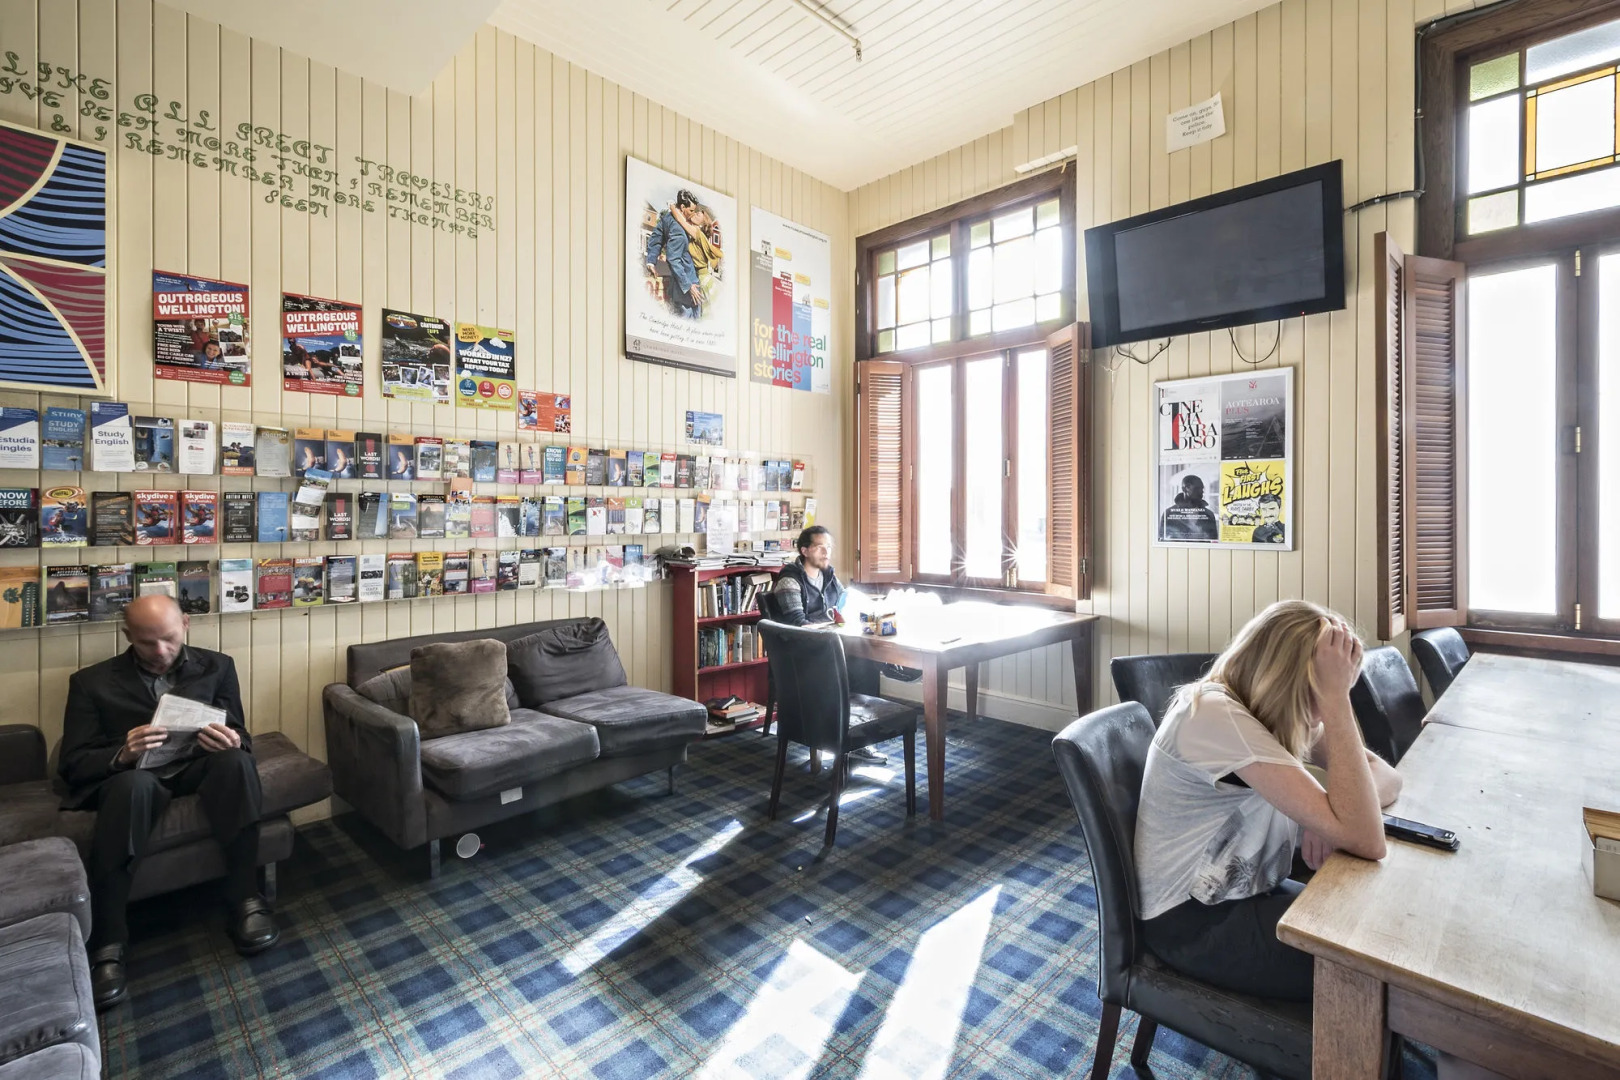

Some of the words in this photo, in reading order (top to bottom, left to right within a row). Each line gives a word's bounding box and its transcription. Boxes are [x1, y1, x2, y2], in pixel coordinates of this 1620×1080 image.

[2, 51, 112, 101] LIKE
[134, 94, 216, 131] ALL
[236, 123, 334, 164] GREAT
[355, 156, 494, 211] TRAVELERS
[1182, 129, 1197, 137] Keep
[1202, 123, 1213, 131] tidy
[51, 114, 71, 133] &
[125, 132, 294, 192] REMEMBER
[309, 183, 375, 212] MORE
[388, 205, 446, 231] THAN
[80, 100, 160, 136] SEEN
[176, 128, 257, 162] MORE
[271, 154, 339, 186] THAN
[367, 182, 496, 232] REMEMBER
[264, 190, 329, 217] SEEN
[158, 293, 243, 304] OUTRAGEOUS
[158, 304, 245, 315] WELLINGTON!
[229, 313, 242, 321] $15
[286, 312, 357, 323] OUTRAGEOUS
[286, 322, 359, 333] WELLINGTON!
[753, 318, 774, 339] for
[777, 324, 800, 345] the
[803, 335, 826, 351] real
[459, 350, 492, 359] WORKED
[499, 354, 512, 362] NZ?
[753, 338, 824, 369] Wellington
[464, 363, 489, 371] REFUND
[489, 366, 508, 374] TODAY
[753, 362, 801, 384] stories
[1226, 397, 1280, 408] AOTEAROA
[98, 430, 125, 438] Study
[1178, 423, 1218, 438] PARA
[95, 438, 129, 446] English
[1178, 435, 1216, 450] DISO
[1240, 473, 1262, 484] FIRST
[1223, 476, 1283, 505] LAUGHS
